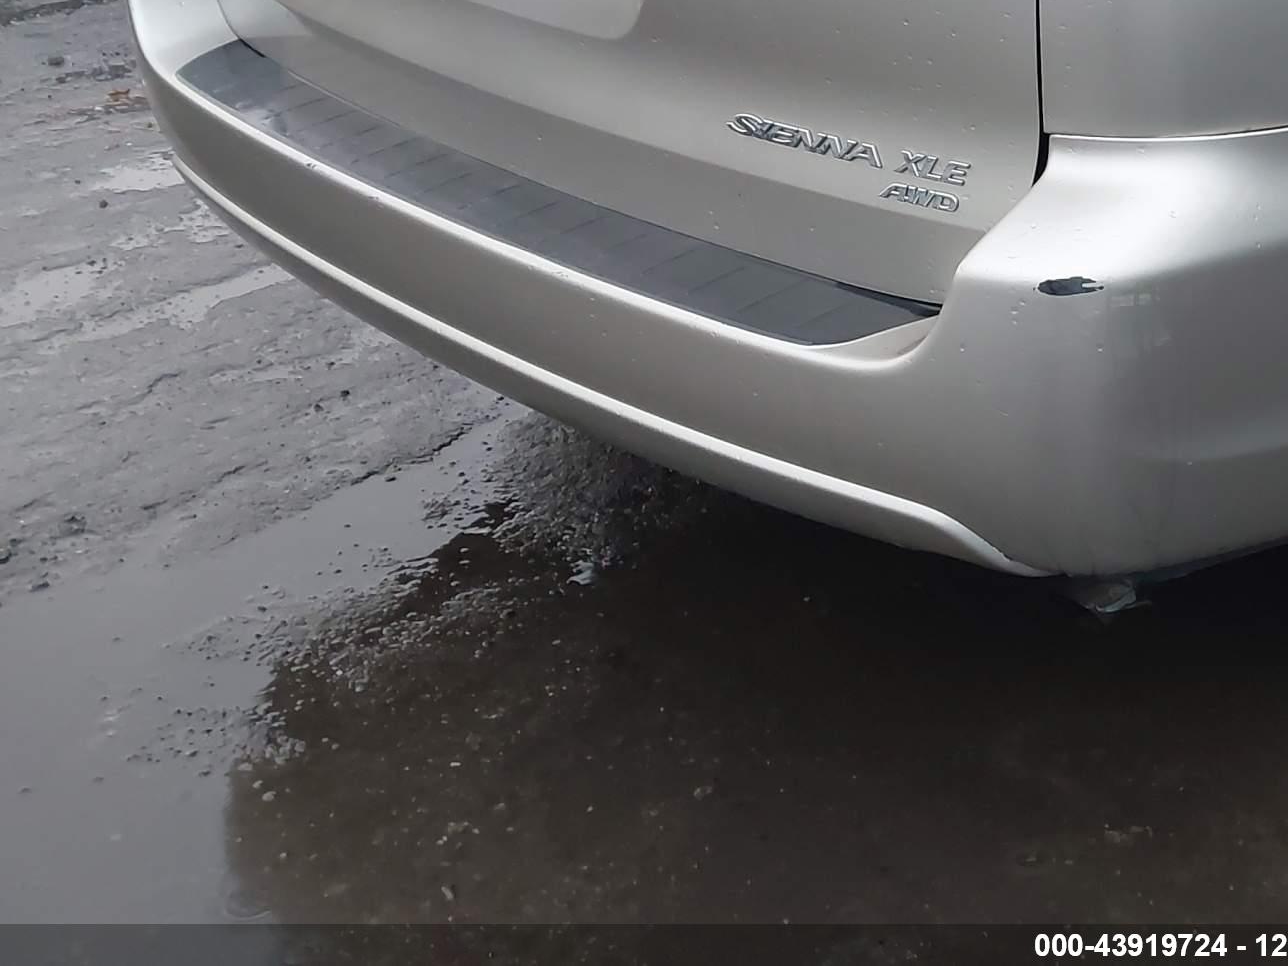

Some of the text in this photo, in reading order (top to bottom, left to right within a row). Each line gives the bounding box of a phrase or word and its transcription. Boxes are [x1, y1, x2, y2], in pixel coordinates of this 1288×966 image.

[726, 113, 971, 186] SIENNA XLE
[879, 183, 960, 212] AWD
